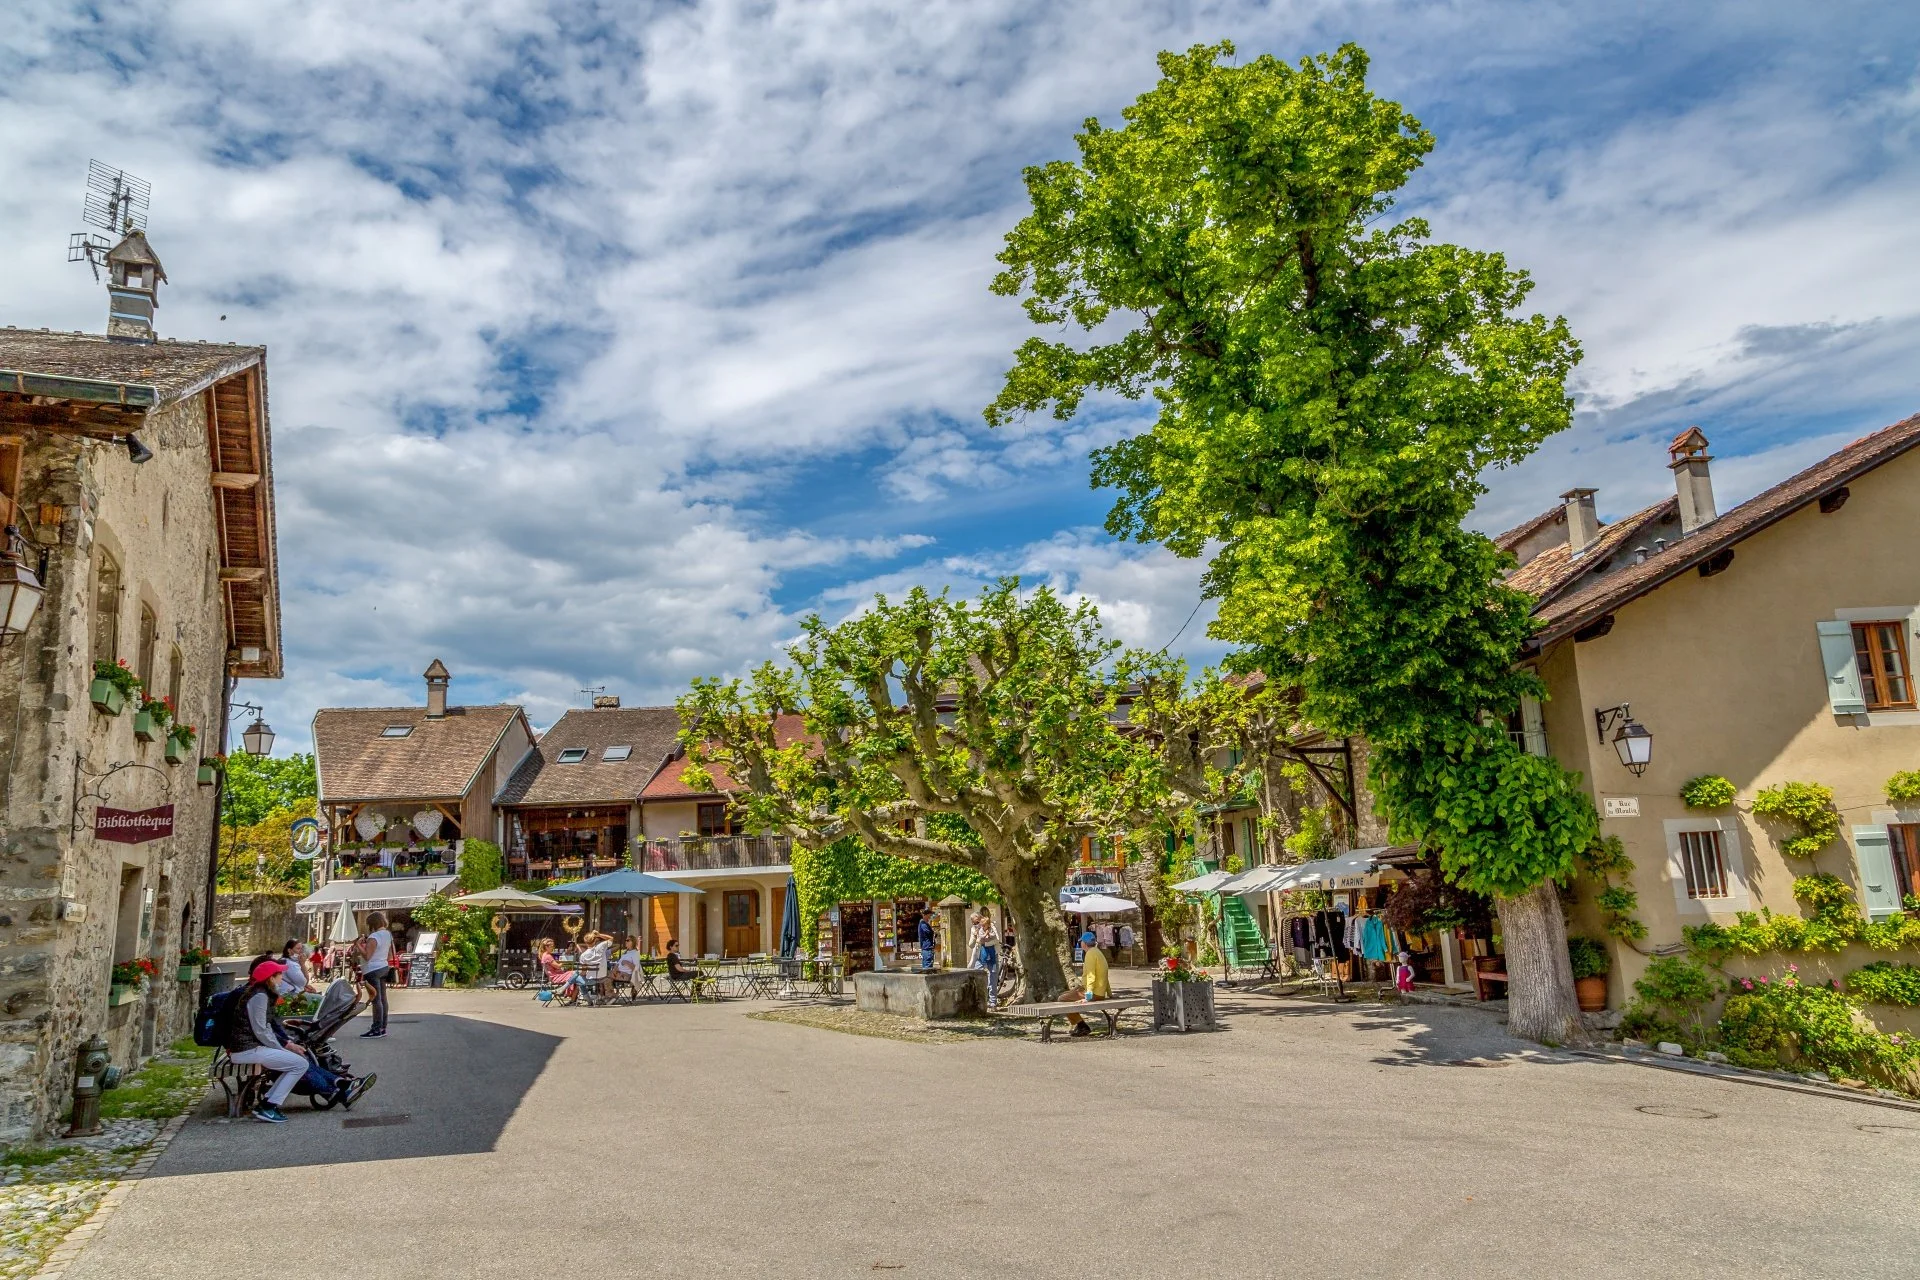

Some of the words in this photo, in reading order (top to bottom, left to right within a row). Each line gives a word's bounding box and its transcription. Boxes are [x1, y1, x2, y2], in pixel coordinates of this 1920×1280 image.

[97, 812, 172, 830] Bibliothèque
[1341, 877, 1364, 887] MARINE
[367, 900, 387, 909] CABRI
